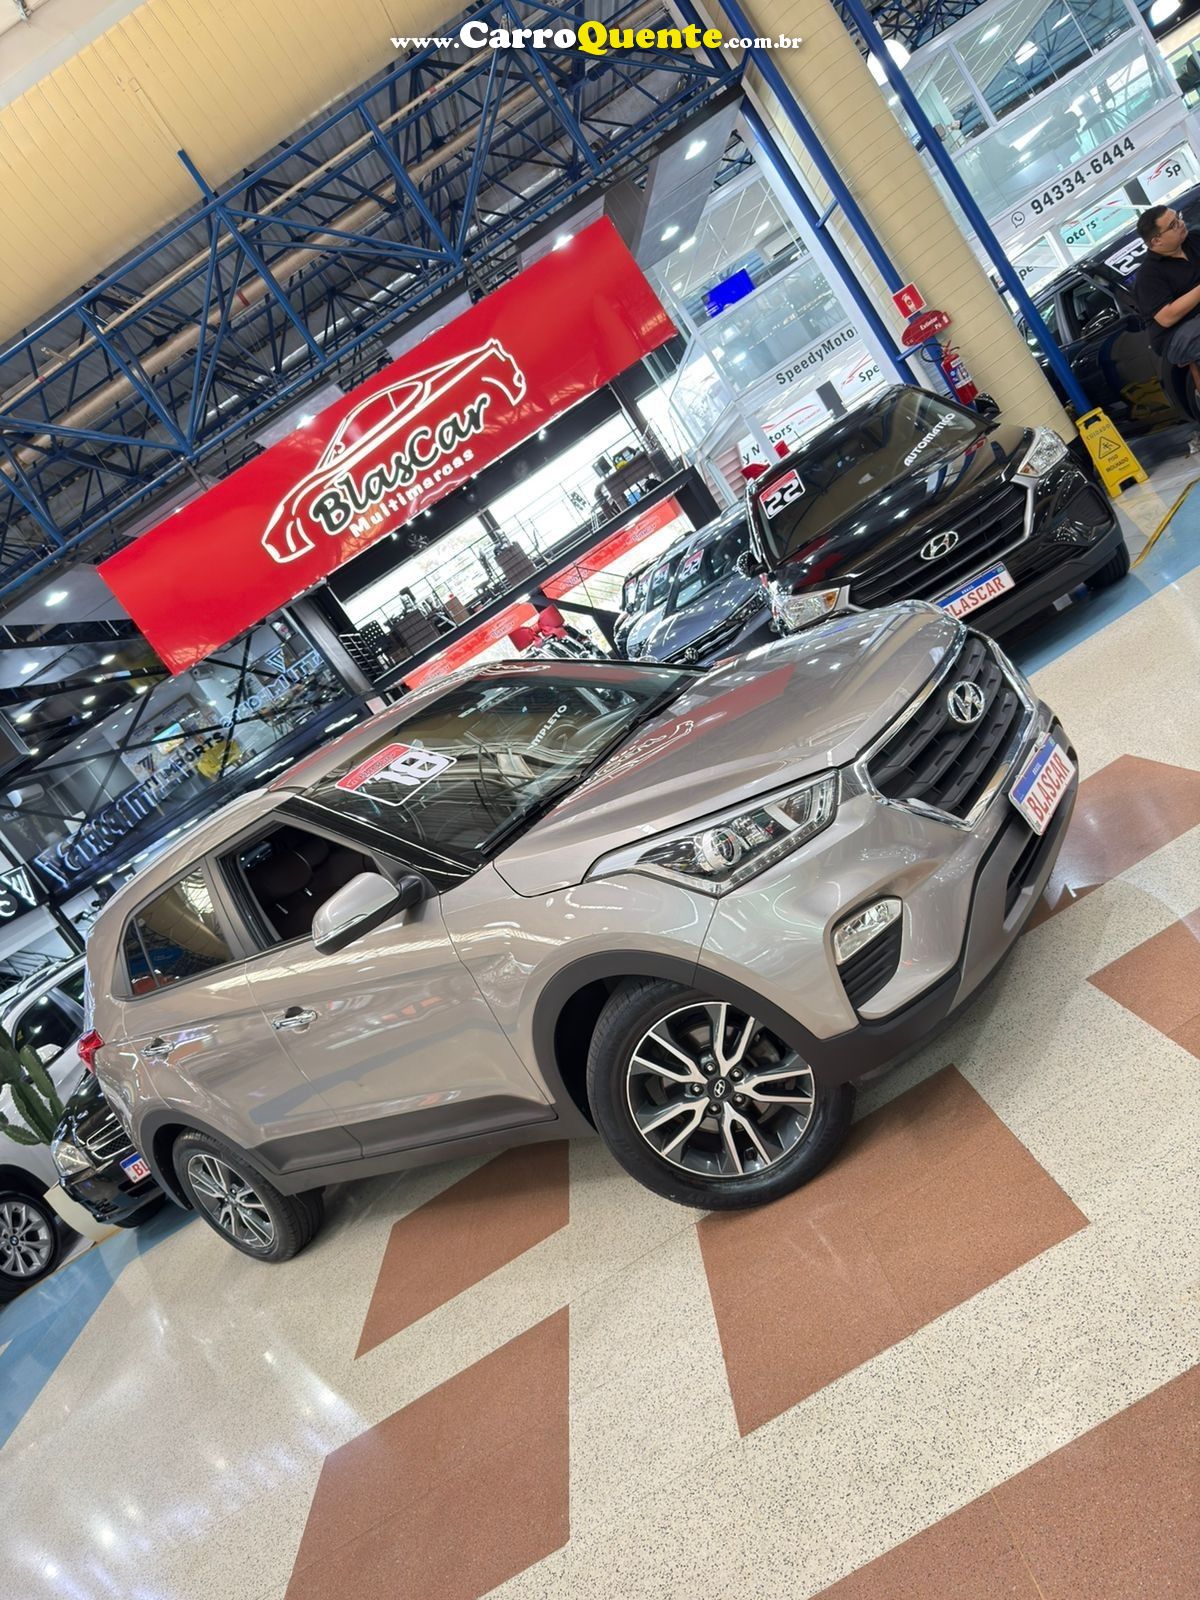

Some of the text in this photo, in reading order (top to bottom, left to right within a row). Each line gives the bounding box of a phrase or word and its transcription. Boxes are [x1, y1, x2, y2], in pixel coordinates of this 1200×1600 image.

[1030, 136, 1136, 215] 94334-6444
[309, 393, 490, 536] BlasCar
[766, 476, 800, 517] 22
[373, 751, 451, 787] 18
[1026, 752, 1070, 823] BLASCAR
